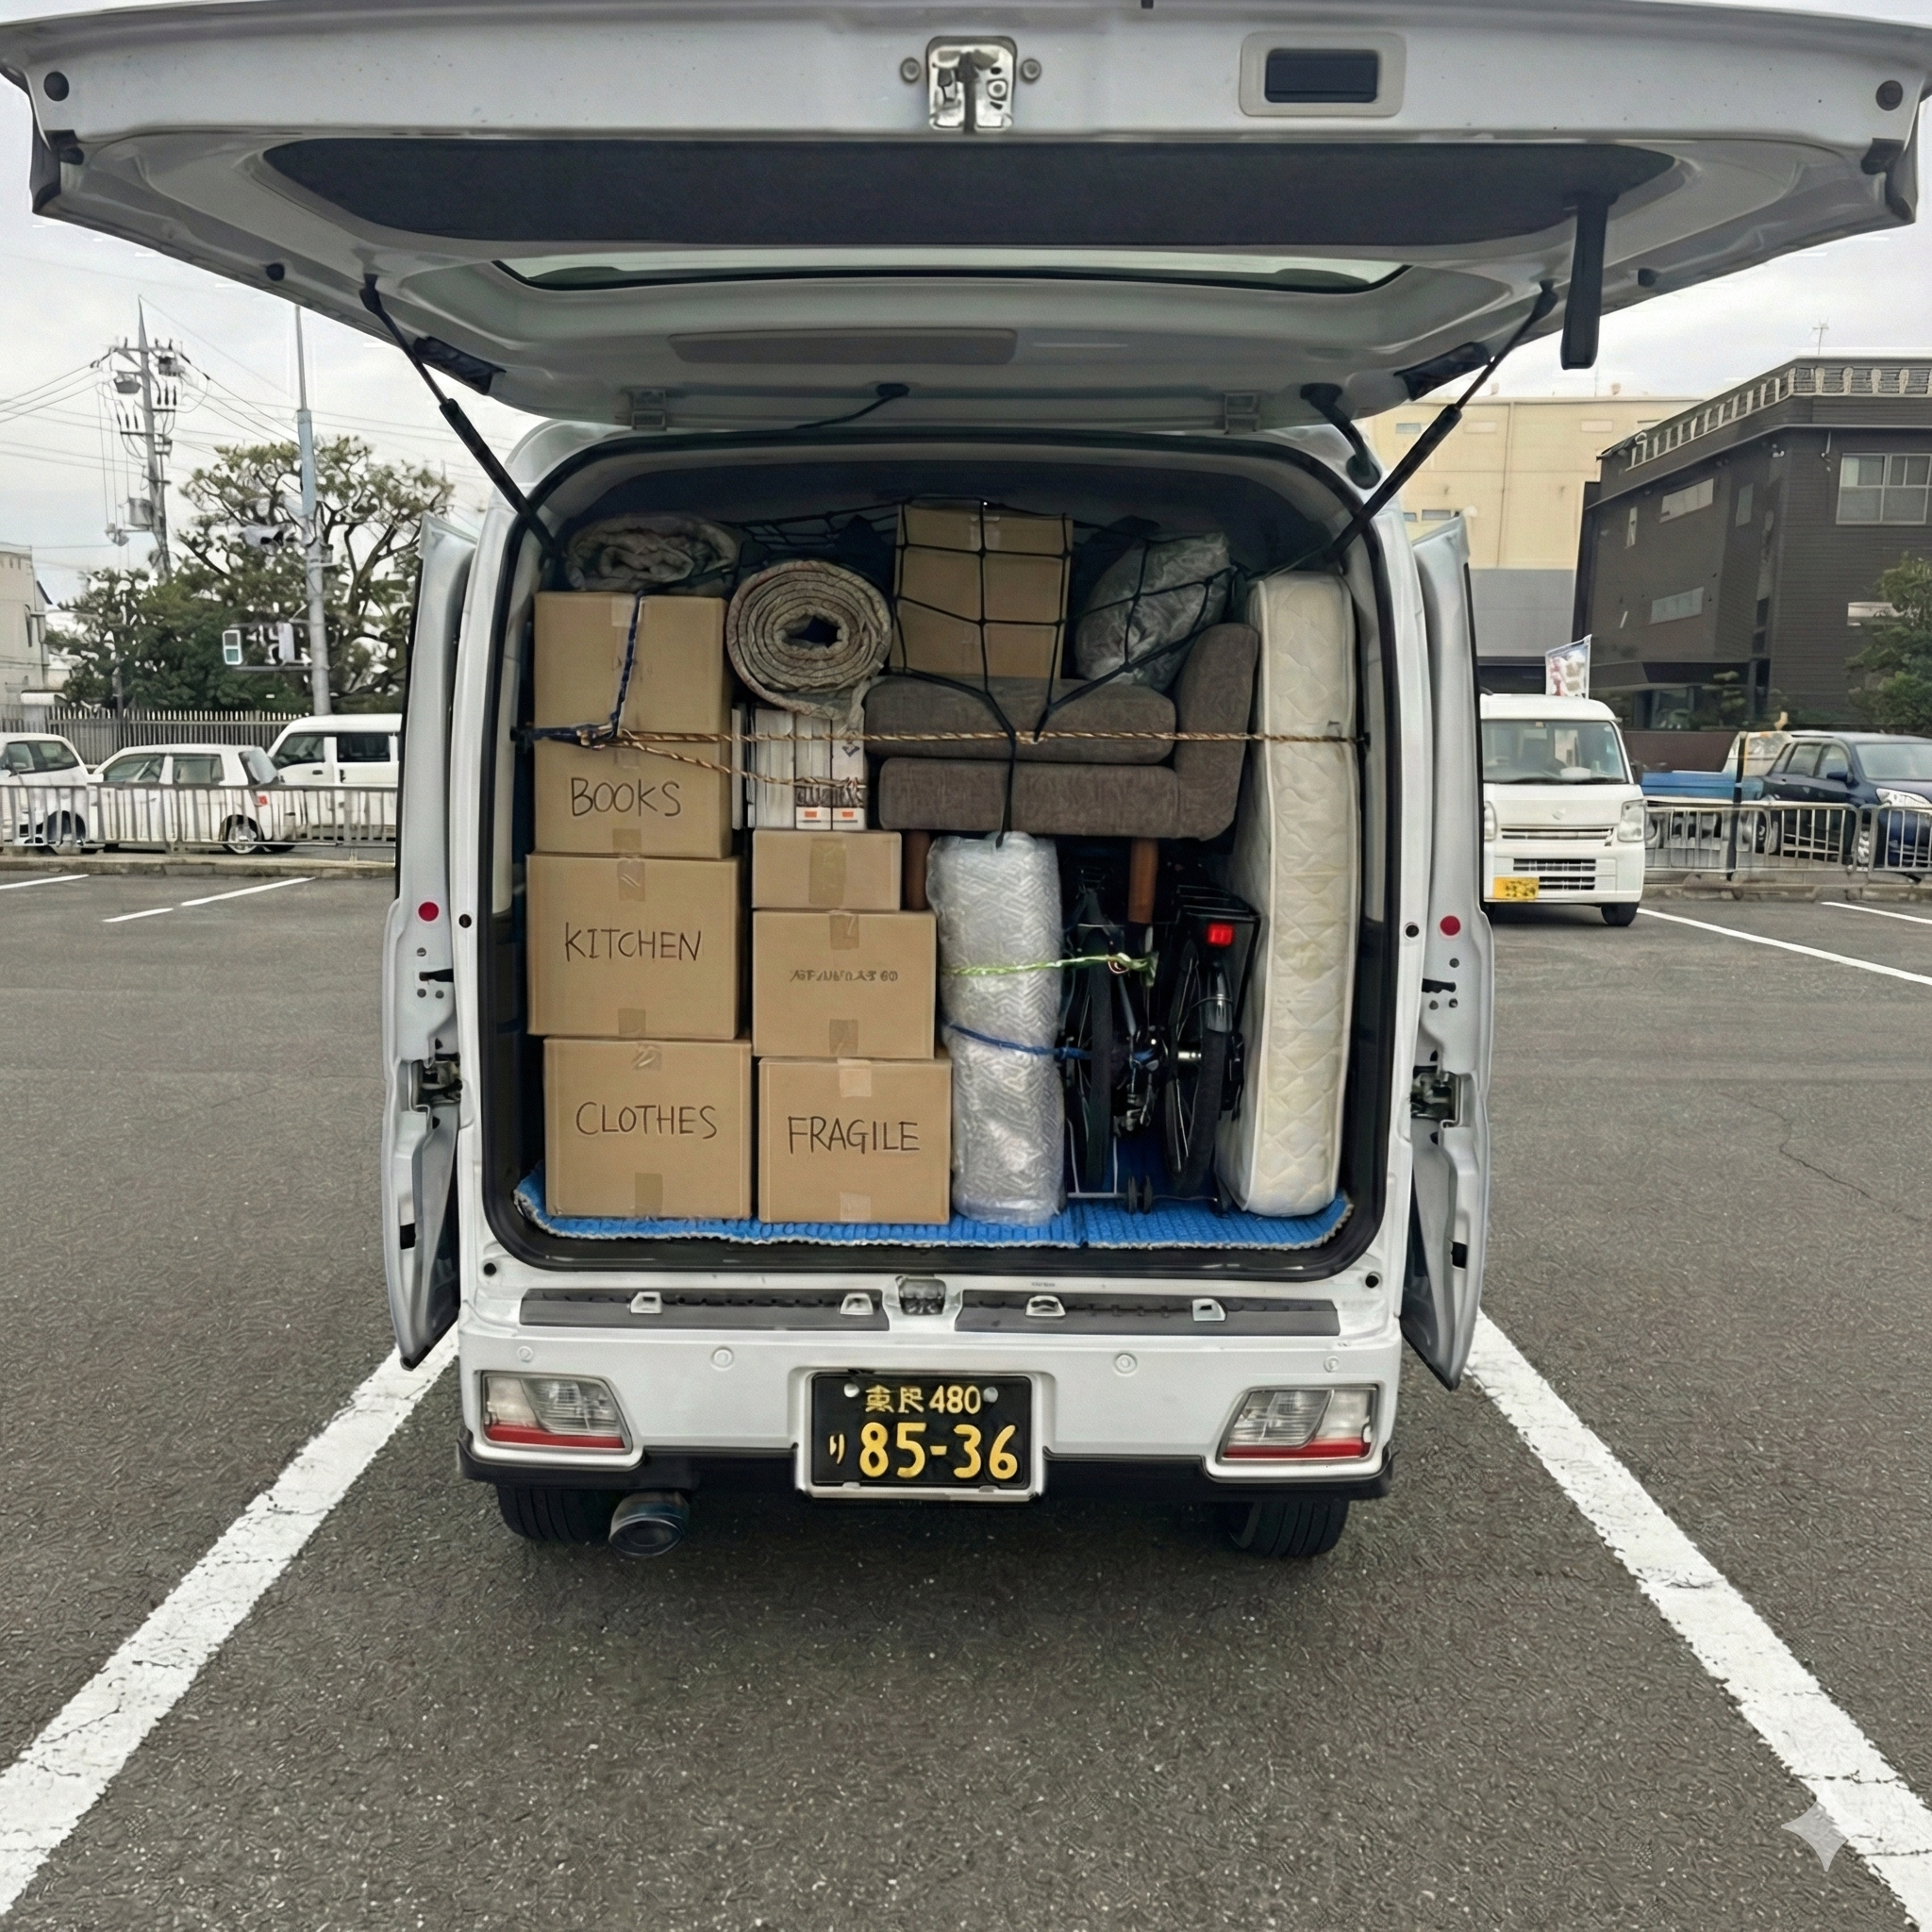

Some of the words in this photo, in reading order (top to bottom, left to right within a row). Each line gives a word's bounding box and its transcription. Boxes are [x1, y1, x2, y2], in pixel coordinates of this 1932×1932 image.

[571, 777, 681, 817] BOOKS
[565, 922, 702, 962] KITCHEN
[575, 1102, 718, 1140] CLOTHES
[788, 1116, 921, 1156] FRAGILE
[929, 1385, 981, 1414] 480
[859, 1422, 1018, 1479] 85-36
